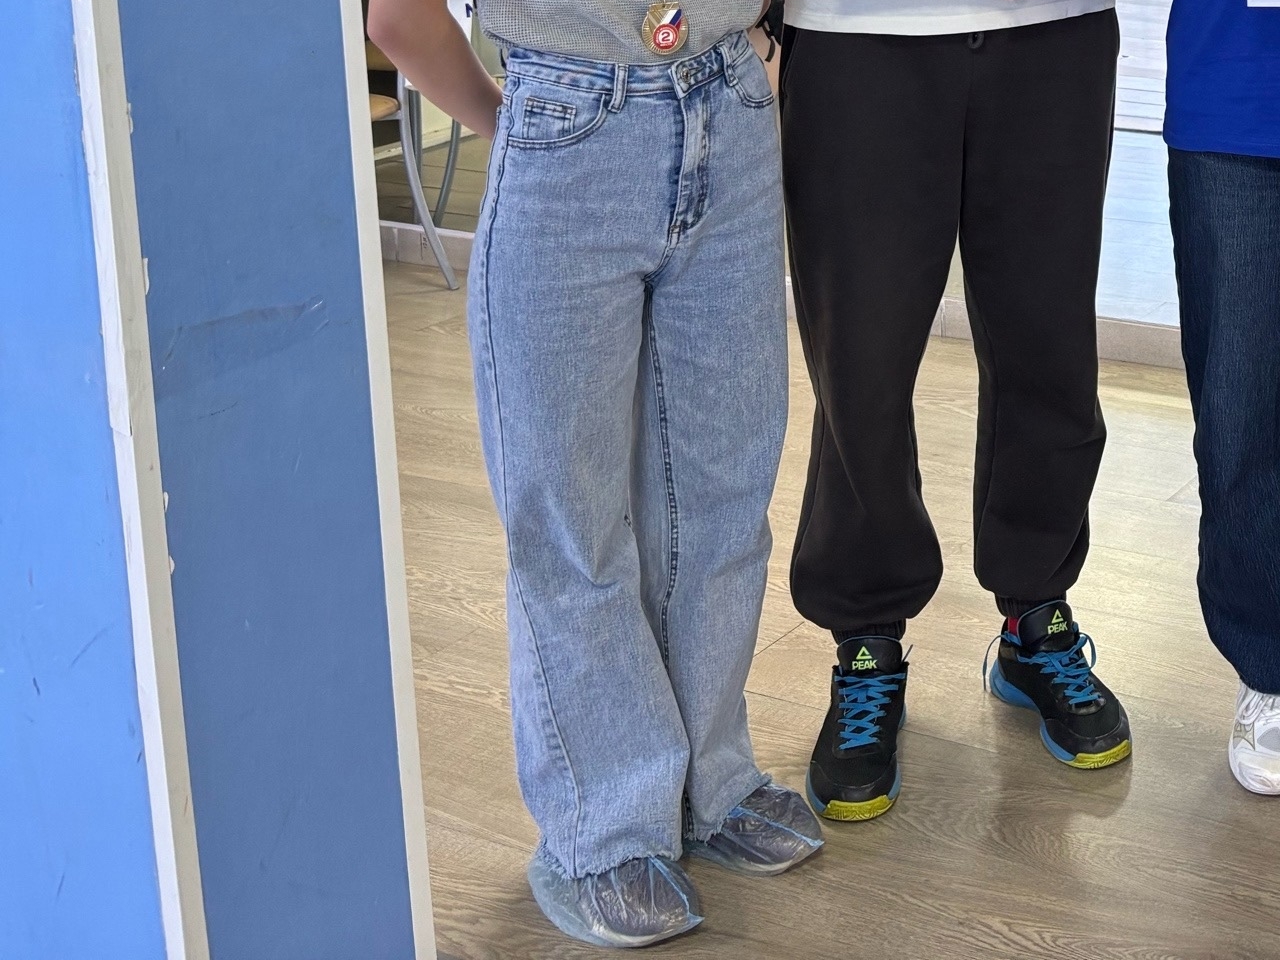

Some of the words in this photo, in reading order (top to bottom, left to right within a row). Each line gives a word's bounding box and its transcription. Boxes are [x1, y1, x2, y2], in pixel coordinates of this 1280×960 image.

[661, 31, 670, 42] 2
[1047, 621, 1068, 635] PEAK
[852, 659, 878, 670] PEAK
